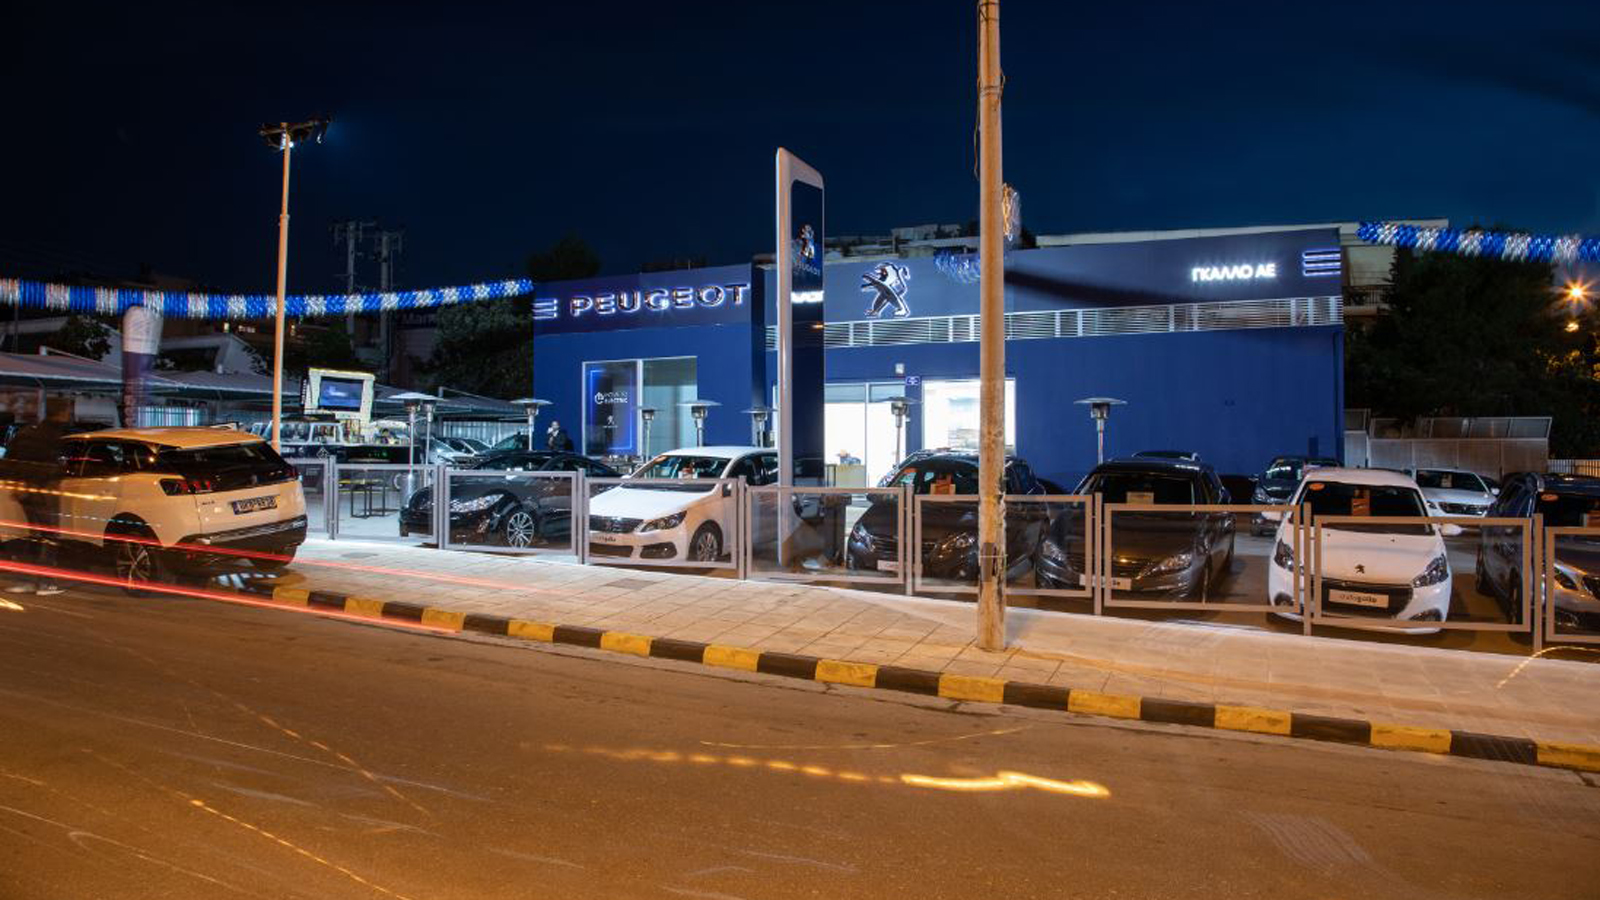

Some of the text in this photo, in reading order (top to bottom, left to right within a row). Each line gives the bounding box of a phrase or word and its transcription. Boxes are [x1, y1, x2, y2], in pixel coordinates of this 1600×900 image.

[1191, 262, 1277, 282] ΓΚΑΛΛΟ ΑΕ
[569, 282, 750, 317] PEUGEOT
